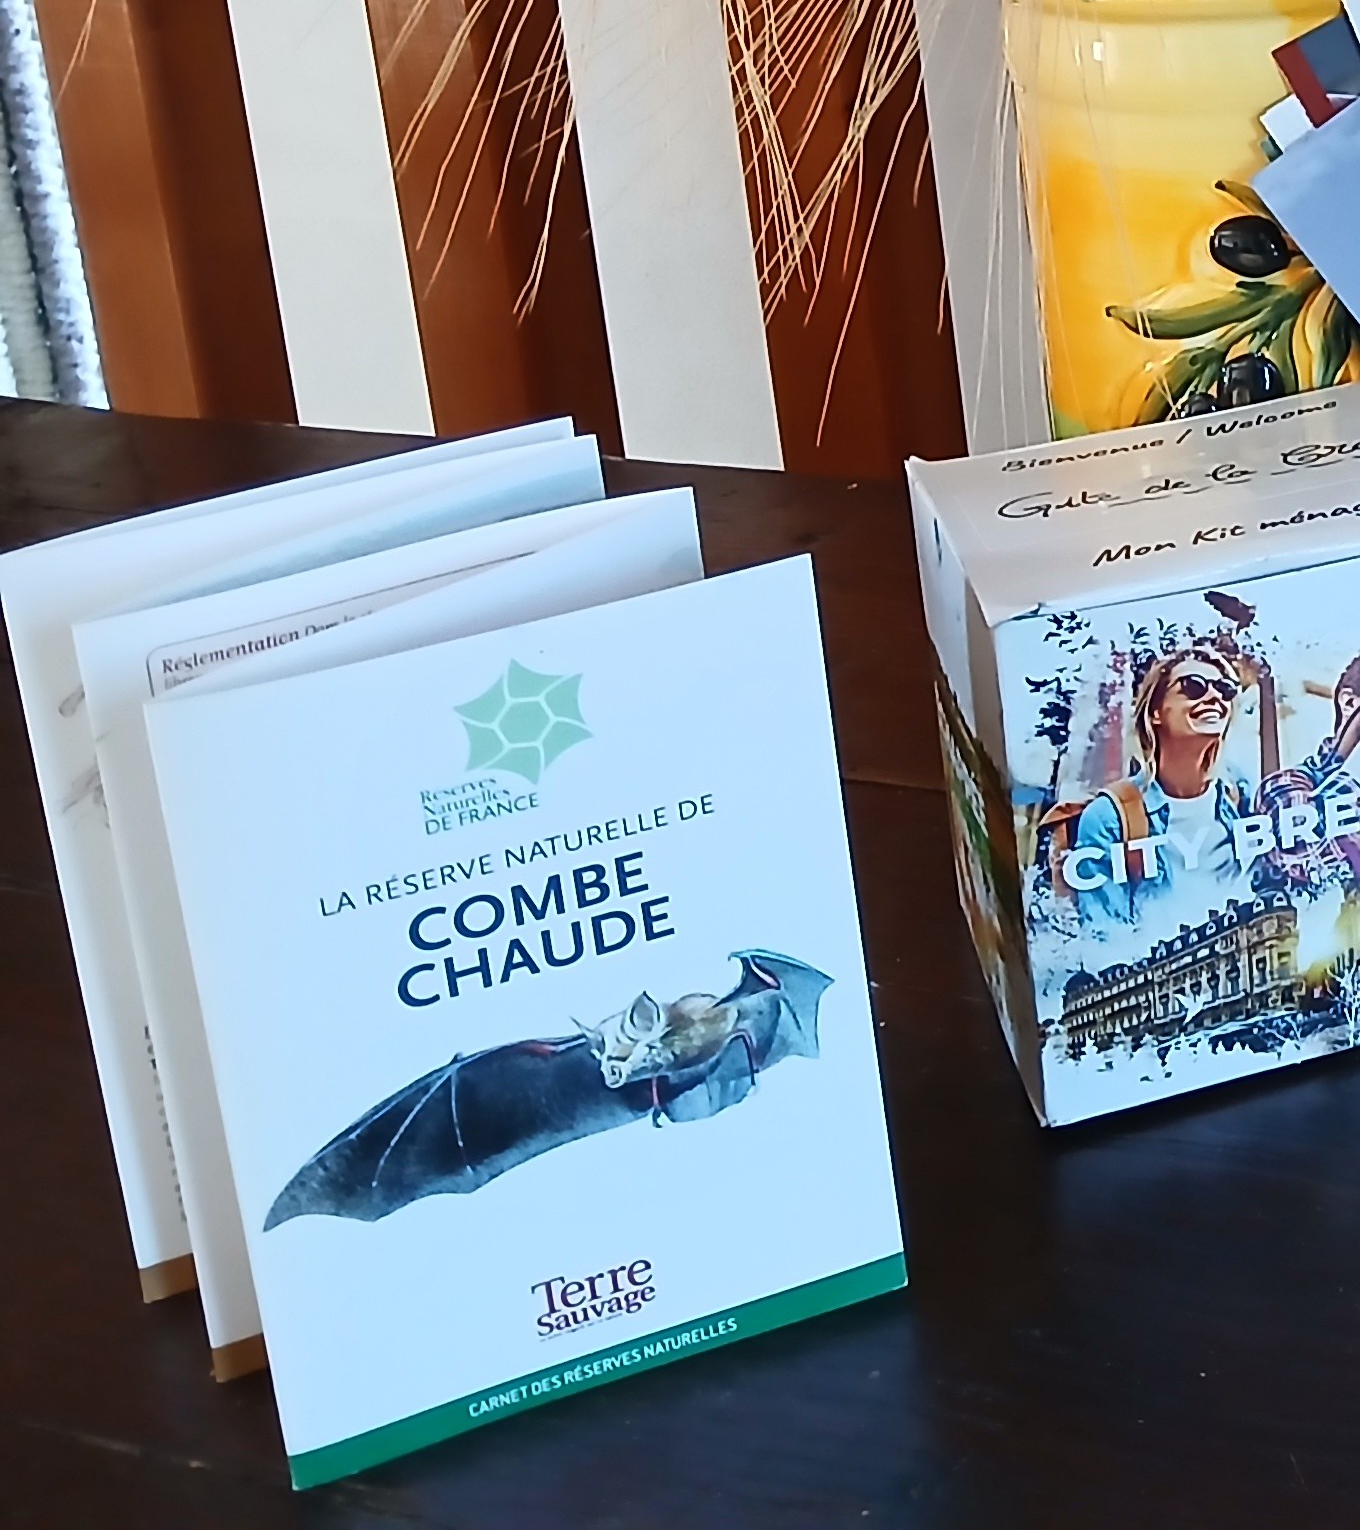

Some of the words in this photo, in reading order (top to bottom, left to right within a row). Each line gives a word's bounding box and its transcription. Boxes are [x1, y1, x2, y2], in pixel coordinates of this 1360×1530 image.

[1002, 439, 1164, 472] Bienvenue
[1206, 400, 1337, 437] Welcome
[1092, 542, 1177, 567] Mon
[1192, 525, 1246, 546] Kit
[425, 816, 452, 836] DE
[458, 792, 539, 827] FRANCE
[320, 891, 356, 917] LA
[366, 853, 495, 906] RÉSERVE
[505, 806, 668, 868] NATURELLE
[678, 793, 715, 821] DE
[1062, 829, 1212, 893] CITY
[408, 851, 649, 952] COMBE
[397, 896, 675, 1008] CHAUDE
[531, 1258, 653, 1315] Terre
[536, 1285, 656, 1338] Sauvage
[468, 1385, 528, 1418] CARNET
[531, 1373, 562, 1396] DES
[564, 1347, 642, 1385] RÉSERVES
[643, 1317, 738, 1359] NATURELLES
